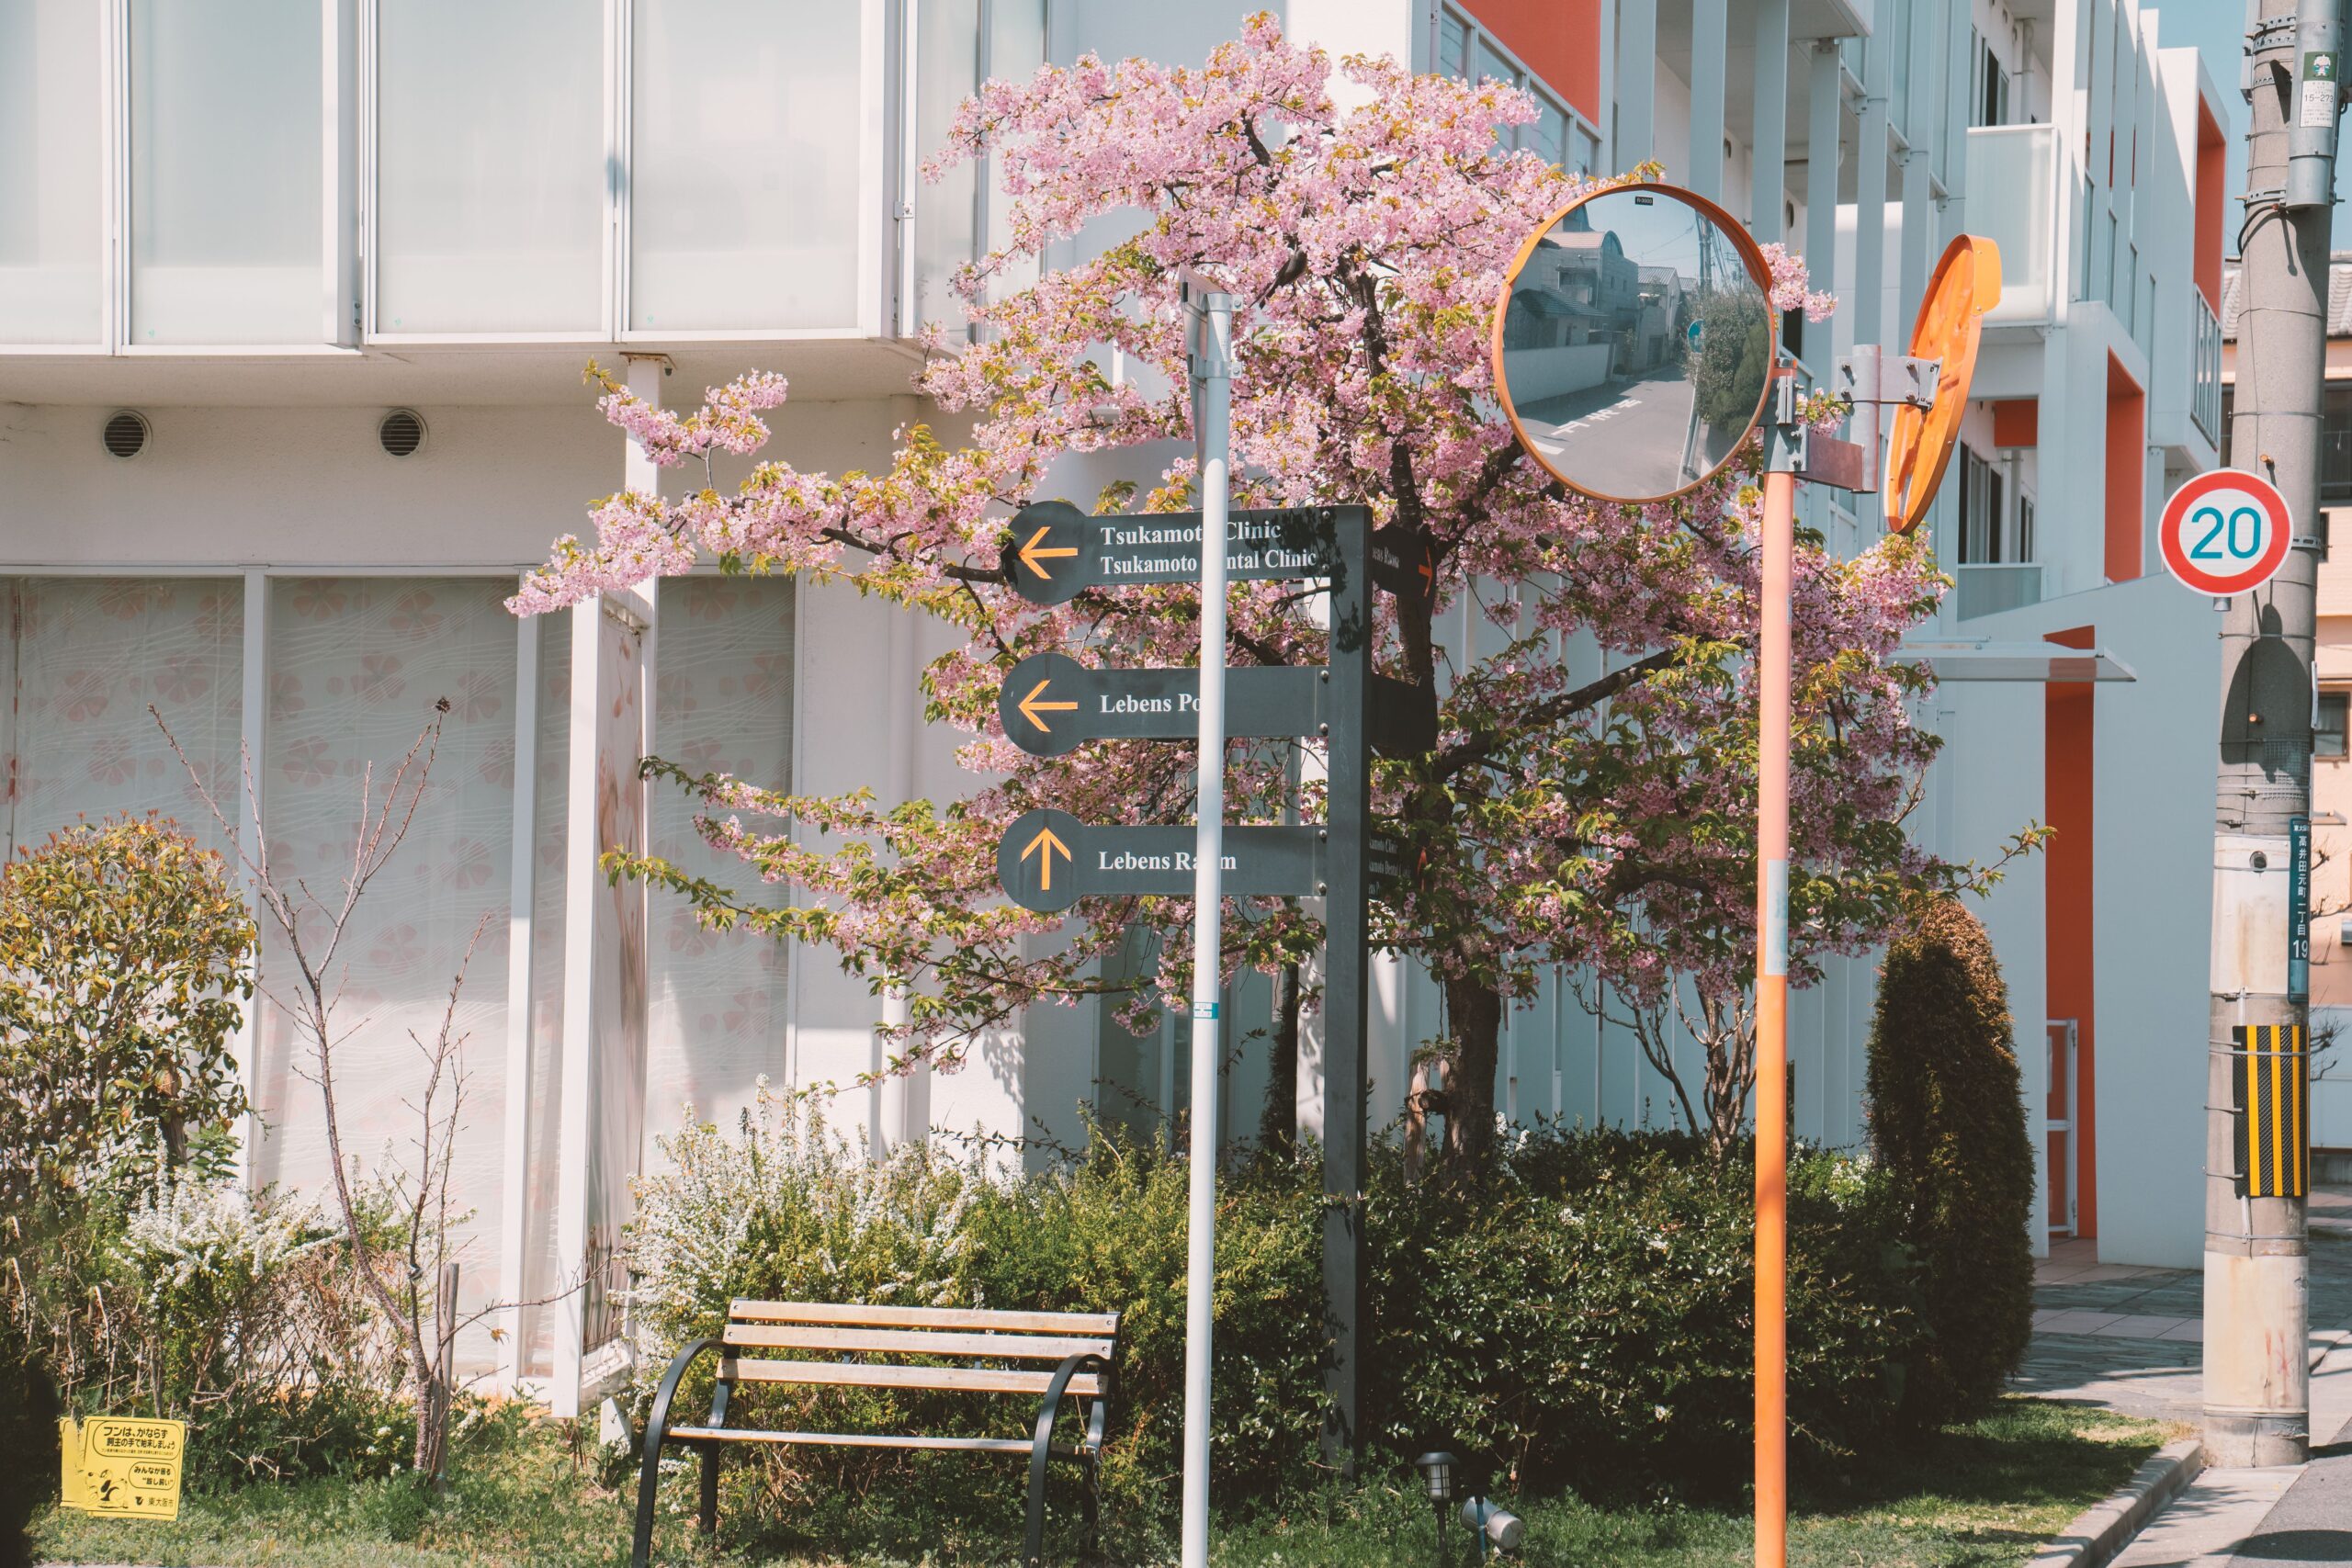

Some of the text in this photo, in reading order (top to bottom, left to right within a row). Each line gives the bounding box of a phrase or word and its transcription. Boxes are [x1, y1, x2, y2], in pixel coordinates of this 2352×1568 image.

[1101, 525, 1203, 545] Tsukamot
[2190, 506, 2262, 559] 20
[1100, 548, 1317, 574] Tsukamoto ntal Clinic
[1100, 694, 1172, 713] Lebens
[1098, 851, 1170, 870] Lebens
[2298, 836, 2308, 936] 高井田元町一丁目
